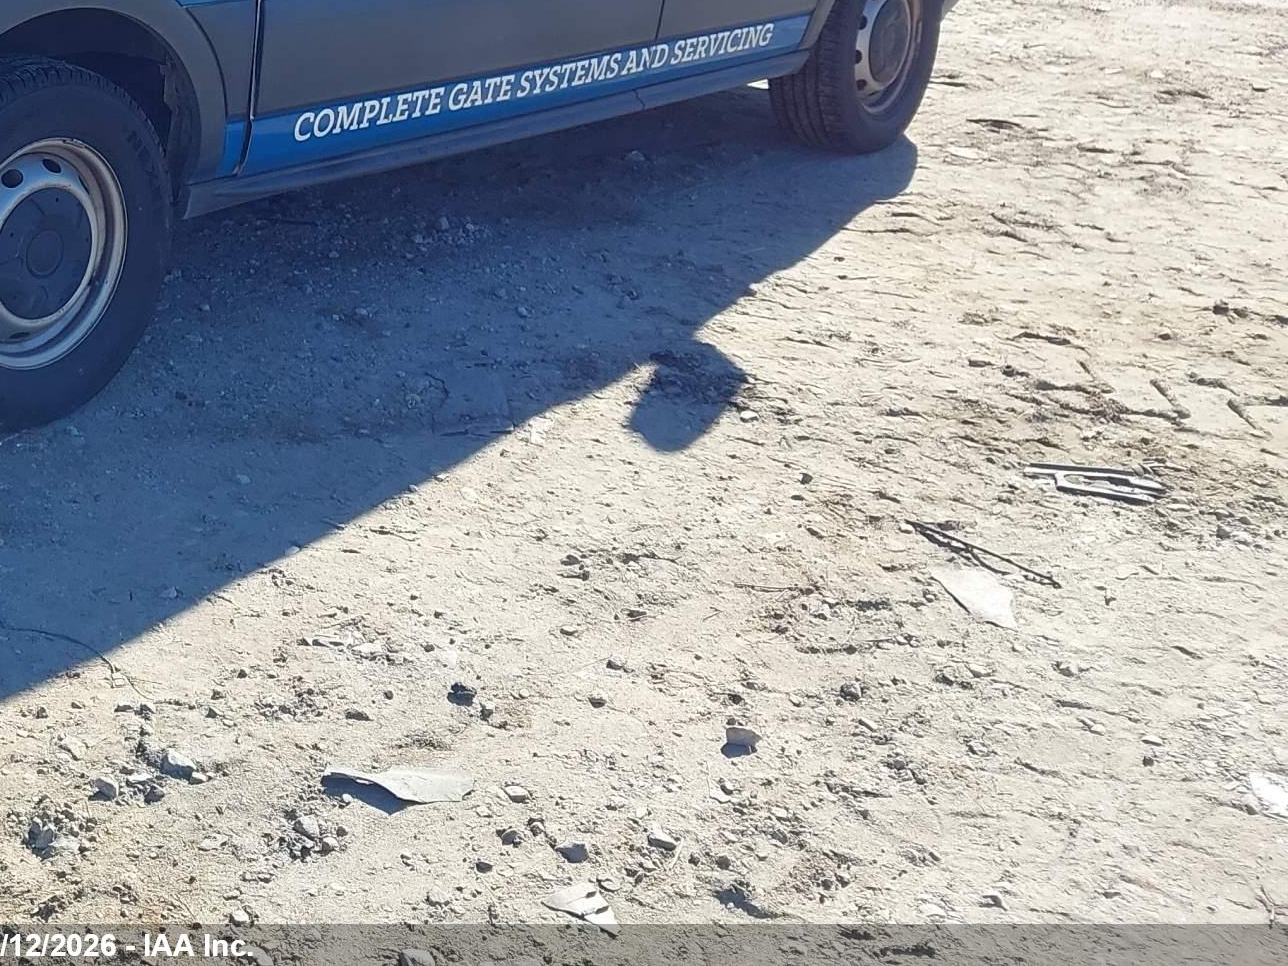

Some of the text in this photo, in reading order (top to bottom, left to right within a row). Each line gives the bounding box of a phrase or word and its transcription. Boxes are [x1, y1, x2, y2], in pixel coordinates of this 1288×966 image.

[294, 22, 775, 142] COMPLETE GATE SYSTEMS AND SERVICING
